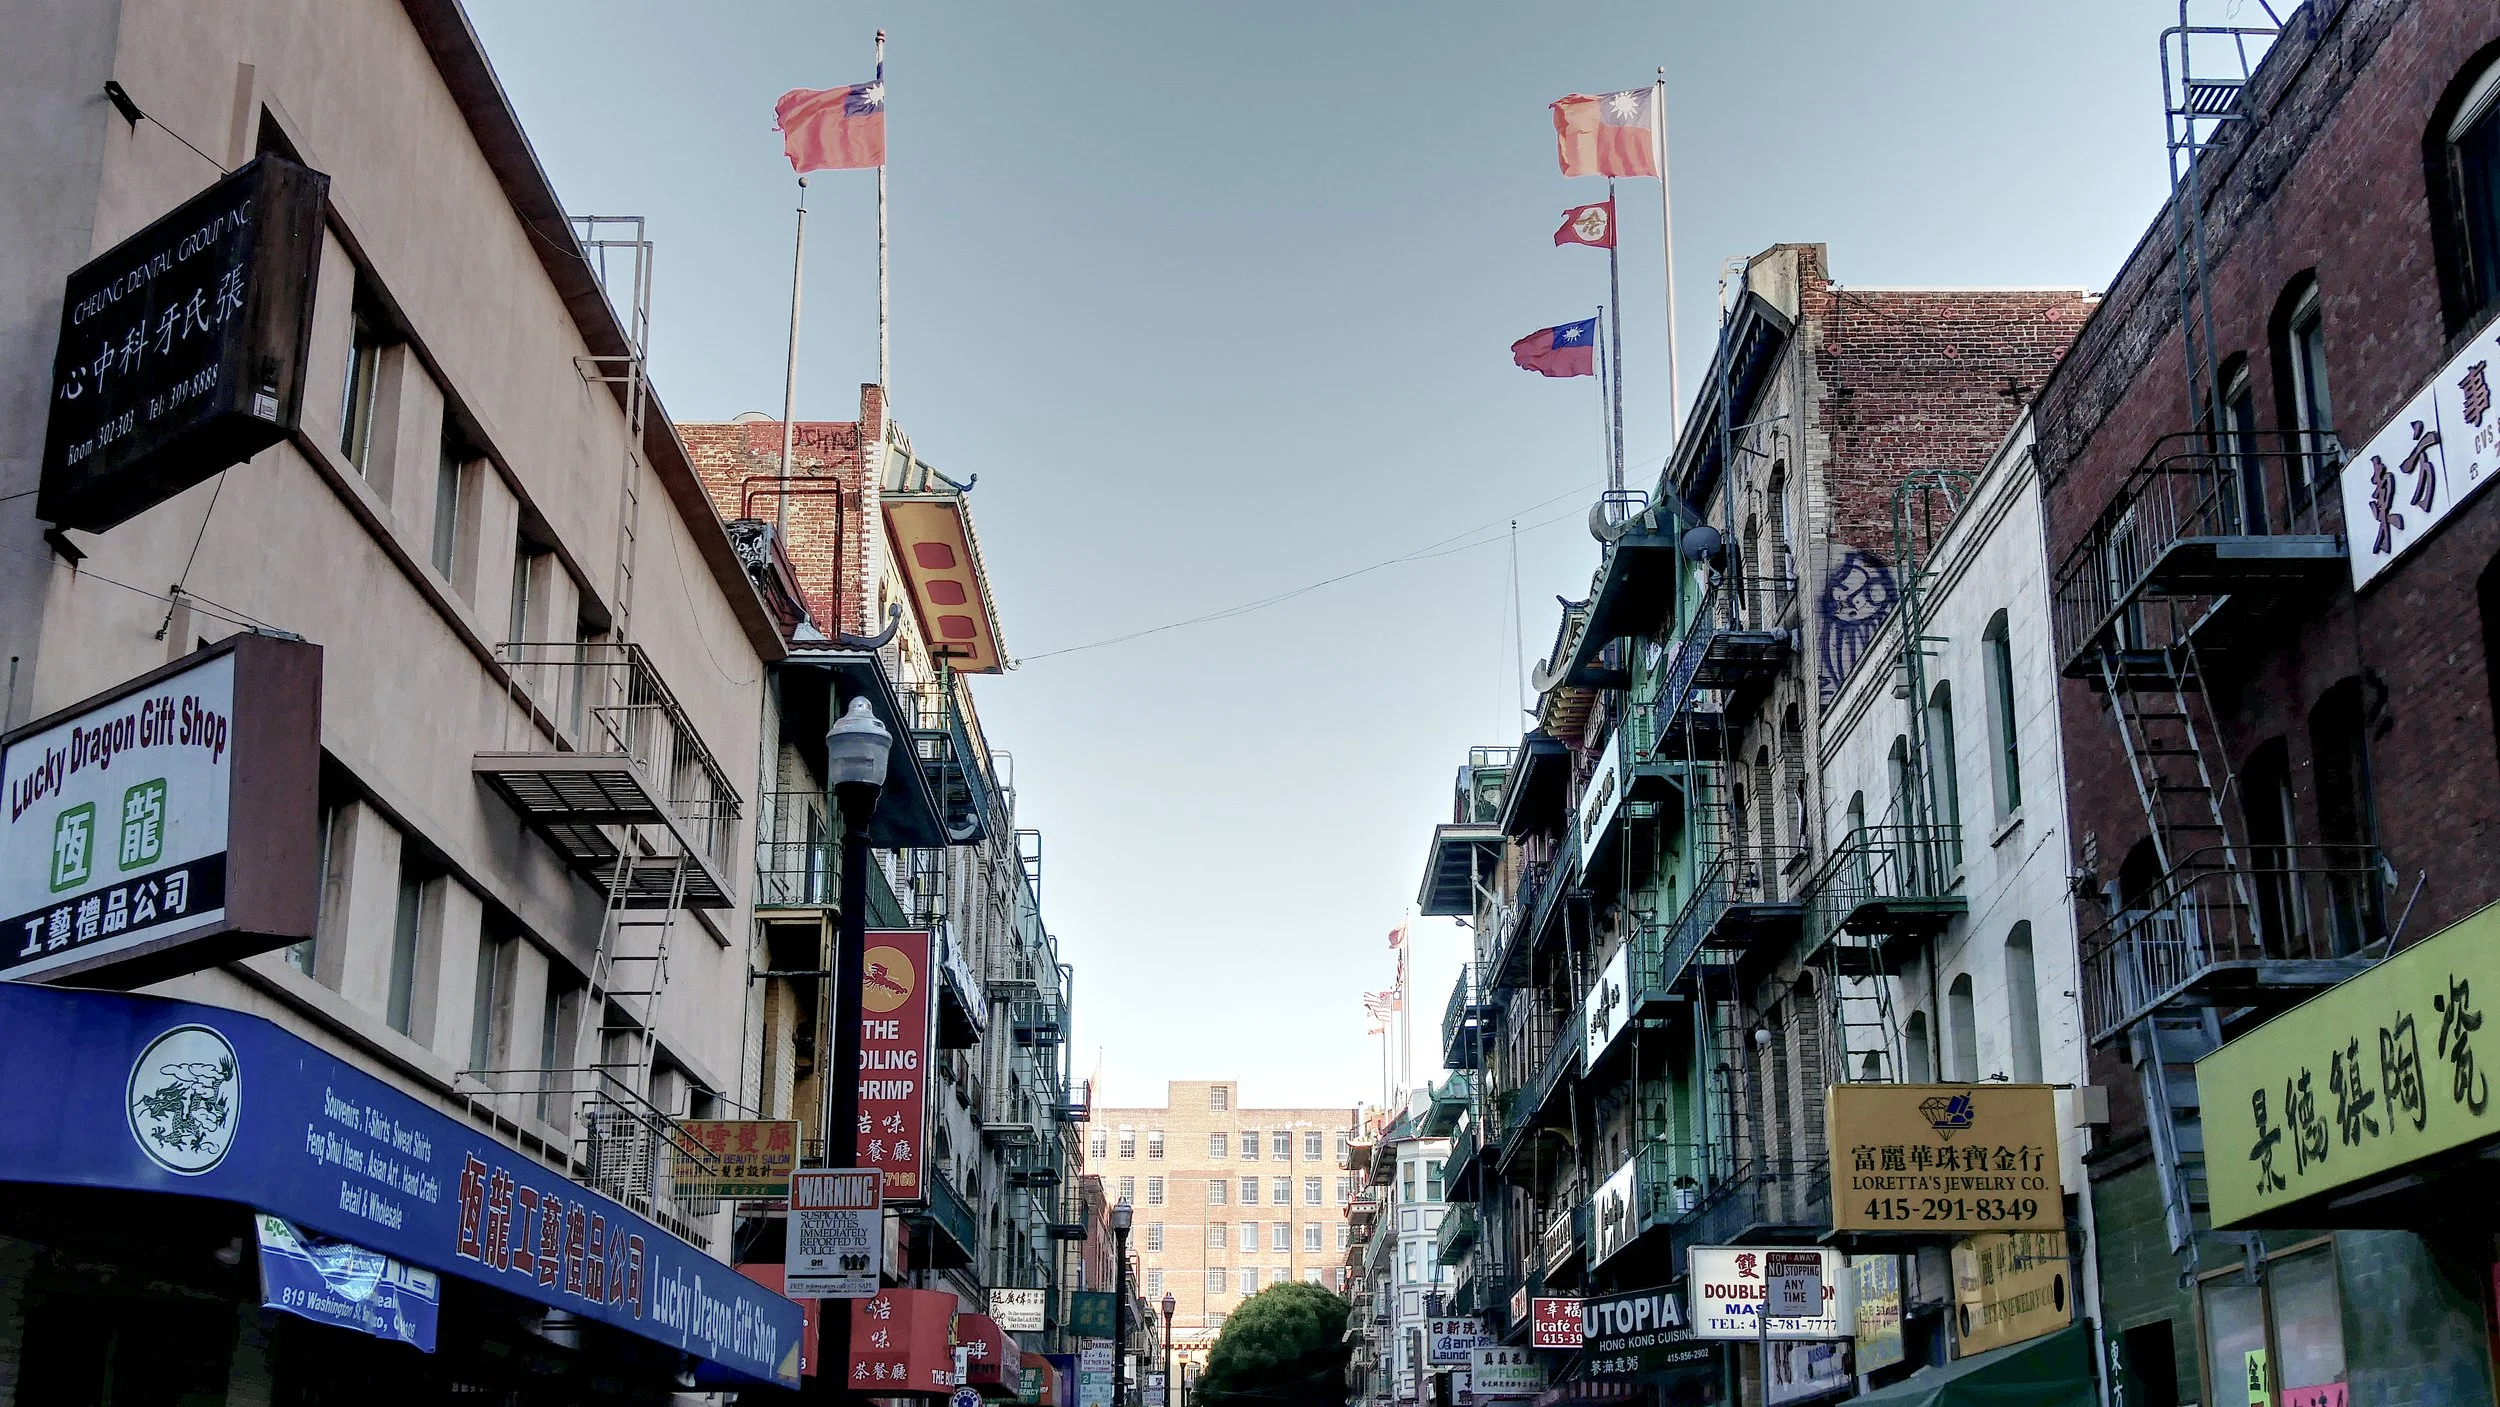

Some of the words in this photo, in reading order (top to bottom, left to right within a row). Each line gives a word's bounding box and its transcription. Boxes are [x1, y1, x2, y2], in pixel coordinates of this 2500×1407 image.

[74, 278, 123, 325] CHEUNG
[127, 249, 173, 293] DENTAL
[178, 217, 223, 262] GROUP
[68, 439, 92, 466] Room
[12, 746, 66, 824] Lucky
[70, 713, 136, 774] Dragon
[140, 695, 176, 748] Gift
[180, 695, 227, 764] Shop
[863, 1020, 899, 1040] THE
[859, 1050, 917, 1070] OILING
[858, 1080, 914, 1100] HRIMP
[393, 1120, 413, 1154] Sweat
[413, 1130, 432, 1163] Shirts
[858, 1139, 912, 1162] 餐廳
[306, 1123, 326, 1166] Feng
[325, 1130, 343, 1164] Shui
[366, 1149, 387, 1181] Asian
[402, 1164, 419, 1197] Hand
[419, 1172, 438, 1204] Crafts
[761, 1154, 790, 1164] SALON
[1851, 1145, 2045, 1172] 富麗華珠寶金行
[798, 1176, 873, 1207] WARNING
[1852, 1176, 1942, 1191] LORETTA'S
[1944, 1177, 2016, 1194] JEWELRY
[2021, 1177, 2050, 1191] CO.
[340, 1180, 362, 1216] Retail
[361, 1189, 368, 1217] &
[368, 1191, 404, 1230] Wholesale
[1864, 1198, 2038, 1222] 415-291-8349
[801, 1211, 857, 1220] SUSPICIOUS
[801, 1220, 858, 1228] ACTIVITIES
[800, 1238, 851, 1246] REPORTED
[854, 1237, 867, 1246] TO
[801, 1228, 868, 1237] IMMEDIATELY
[800, 1246, 836, 1255] POLICE
[1768, 1262, 1783, 1277] NO
[1785, 1265, 1820, 1276] STOPPING
[1704, 1284, 1766, 1300] DOUBLE
[1785, 1280, 1804, 1290] ANY
[282, 1286, 304, 1307] 819
[307, 1291, 353, 1319] Washington
[1783, 1292, 1807, 1303] TIME
[652, 1254, 692, 1348] Lucky
[692, 1274, 733, 1358] Dragon
[734, 1295, 754, 1357] Gift
[754, 1304, 777, 1378] Shop
[1544, 1301, 1582, 1319] 幸福
[1582, 1293, 1681, 1338] UTOPIA
[1709, 1319, 1745, 1330] TEL:
[1749, 1319, 1836, 1331] 45-781-7777
[1600, 1338, 1625, 1352] HONG
[1628, 1334, 1655, 1349] KONG
[1433, 1350, 1471, 1360] Laundr
[931, 1369, 945, 1385] THE
